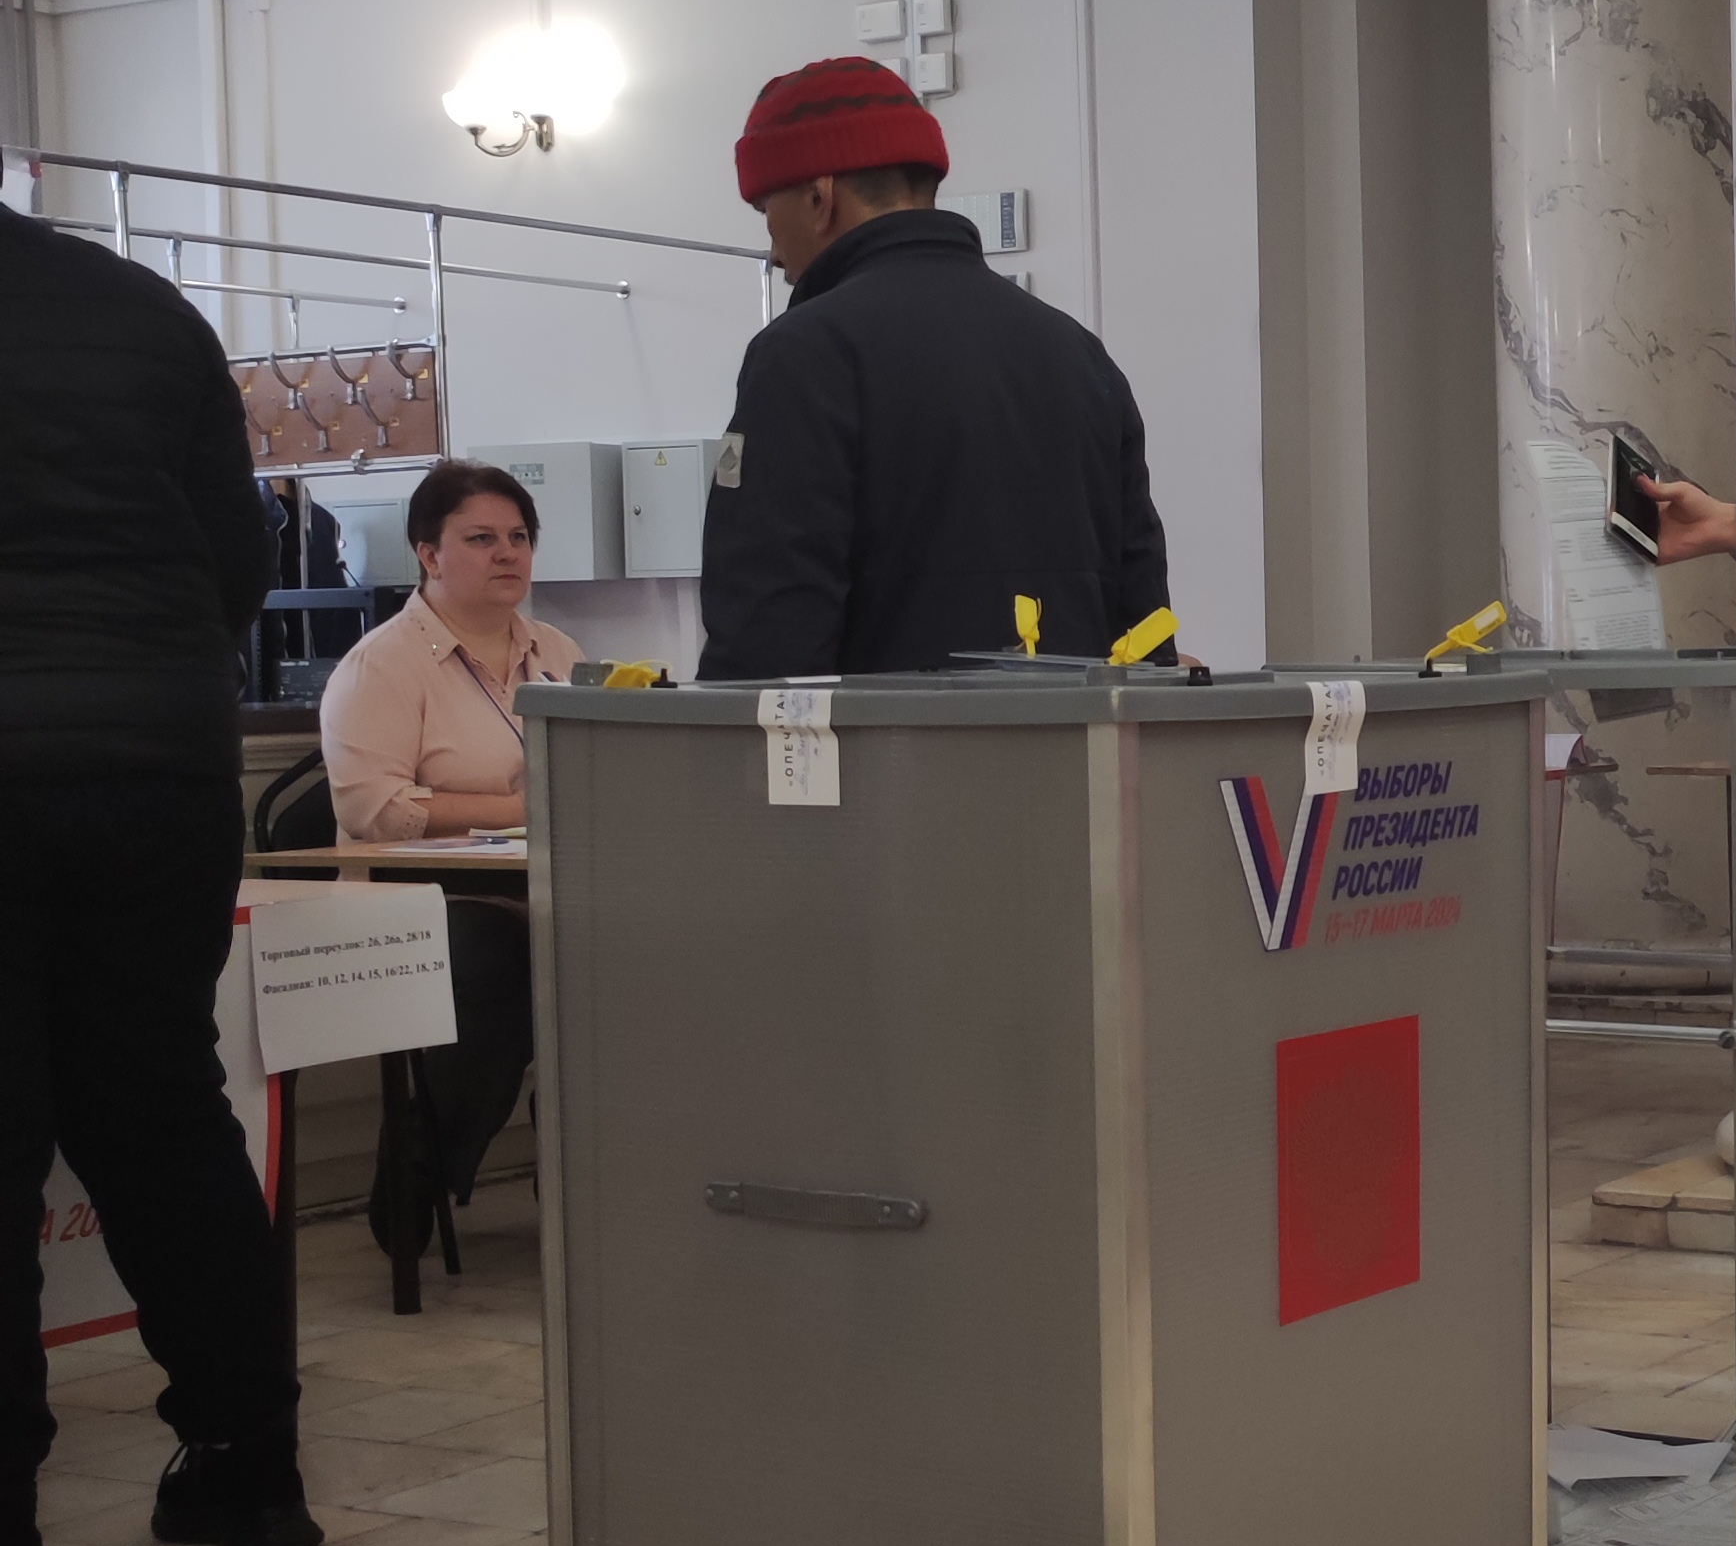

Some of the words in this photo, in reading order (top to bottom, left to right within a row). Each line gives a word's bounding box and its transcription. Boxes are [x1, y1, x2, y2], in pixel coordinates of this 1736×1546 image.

[1354, 761, 1452, 802] ВЫБОРЫ
[1343, 804, 1479, 851] ПРЕЗИДЕНТА
[1331, 856, 1423, 901] РОССИИ
[1370, 900, 1423, 937] МАРТА
[1424, 894, 1462, 929] 2024
[260, 945, 311, 963] Торговый
[313, 940, 365, 956] переулок:
[406, 929, 432, 943] 28/18
[317, 976, 332, 987] 10,
[334, 973, 349, 984] 12,
[351, 971, 366, 982] 14,
[368, 968, 382, 980] 15,
[385, 964, 413, 978] 16/22,
[416, 962, 430, 974] 18,
[433, 960, 445, 972] 20
